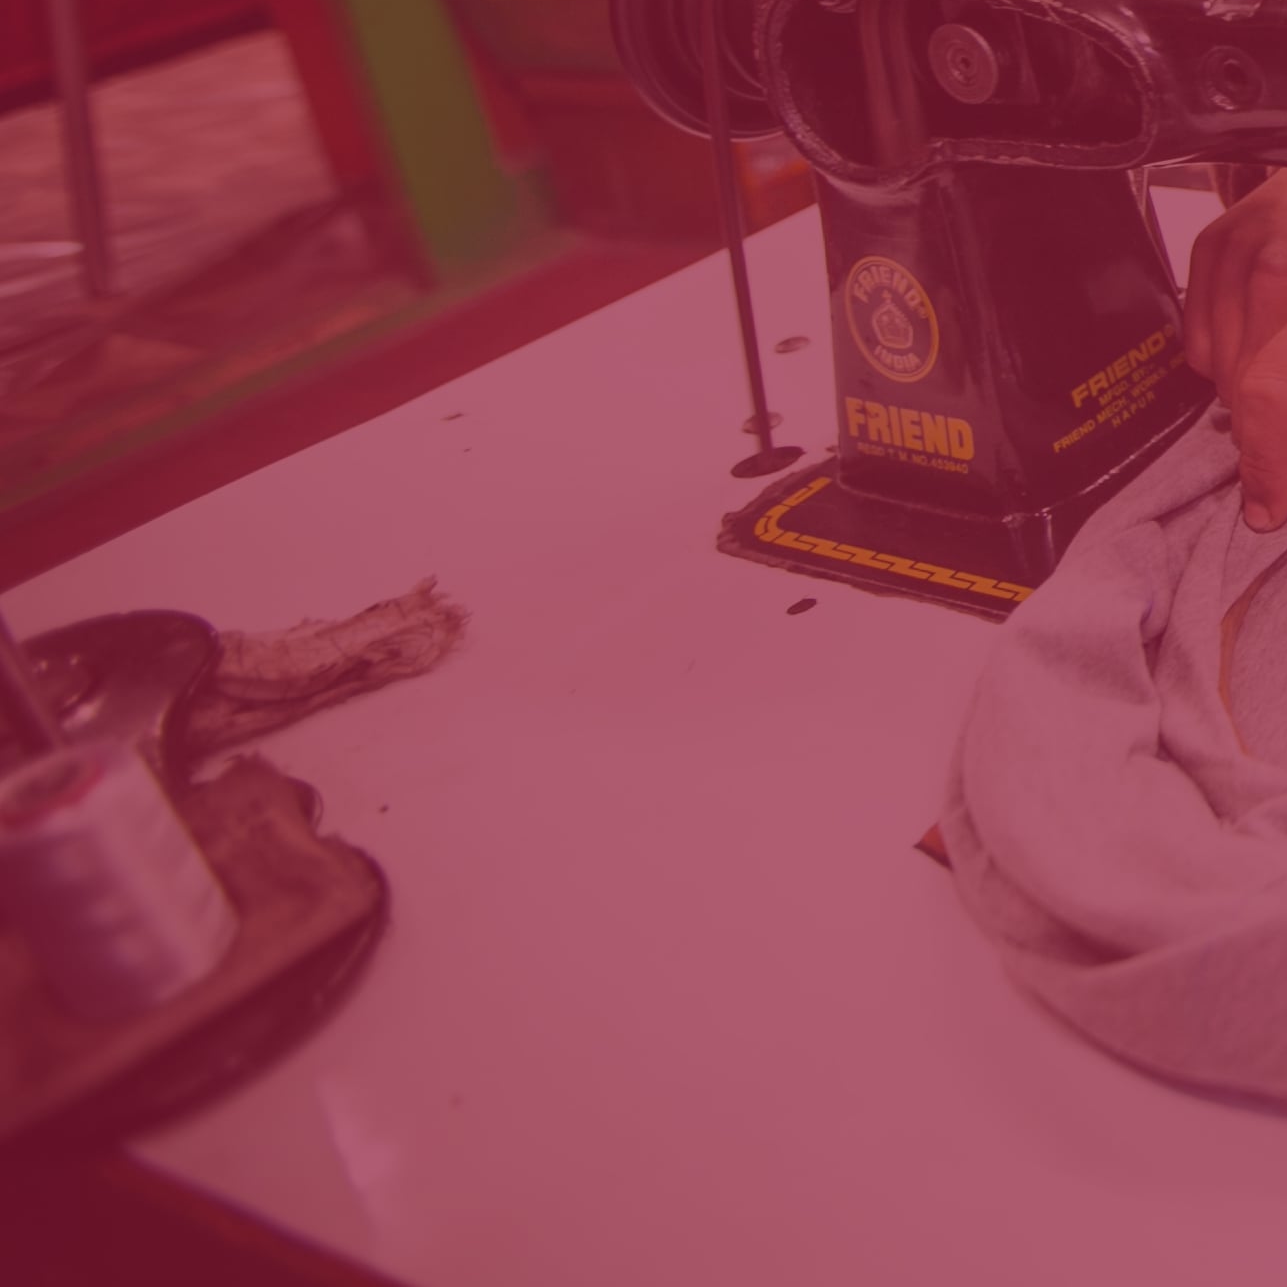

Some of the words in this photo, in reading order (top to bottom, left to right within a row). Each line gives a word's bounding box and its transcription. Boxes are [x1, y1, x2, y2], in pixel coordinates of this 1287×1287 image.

[873, 344, 922, 373] INDIA
[1071, 330, 1166, 409] FRIEND
[844, 396, 976, 461] FRIEND
[1053, 419, 1096, 454] FRIEND
